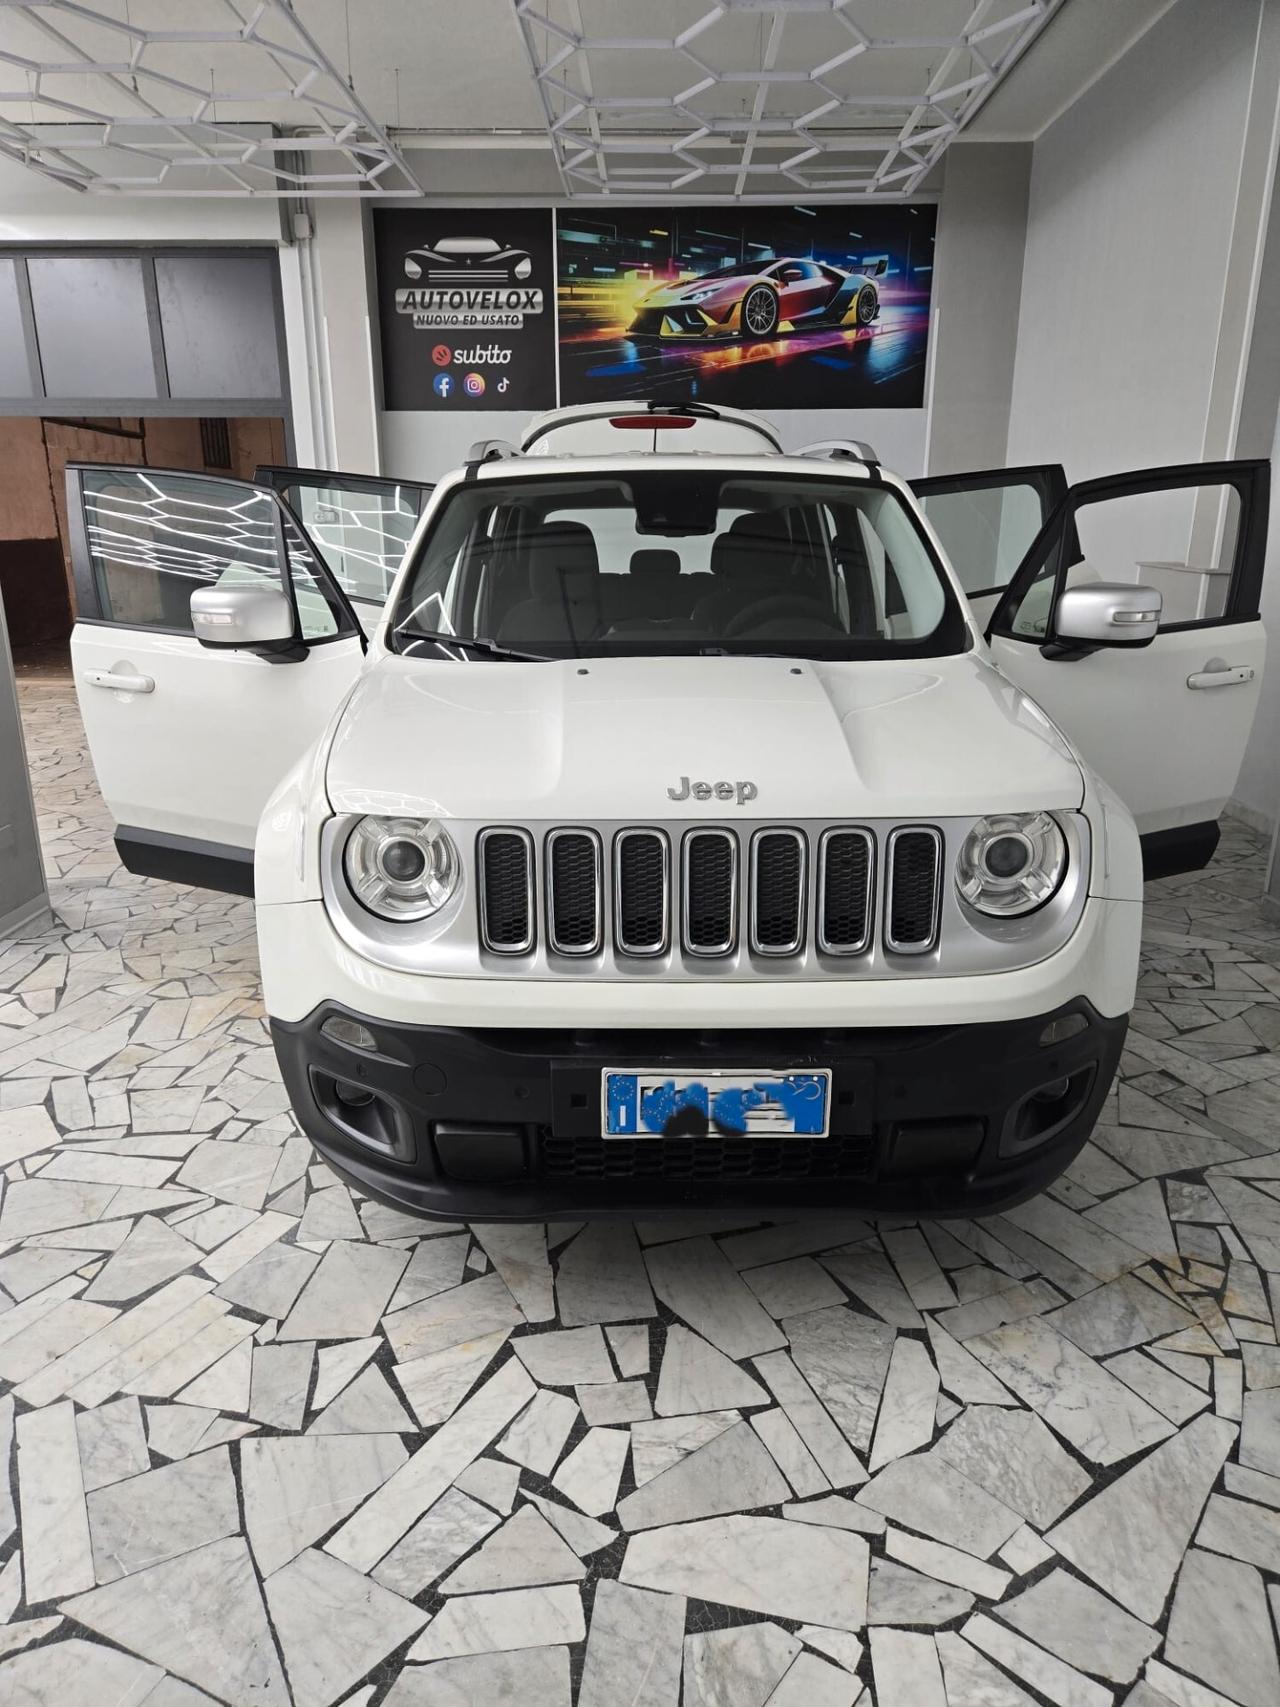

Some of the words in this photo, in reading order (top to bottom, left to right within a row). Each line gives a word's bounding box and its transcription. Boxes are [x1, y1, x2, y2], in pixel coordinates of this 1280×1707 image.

[402, 290, 538, 310] AUTOVELOX
[416, 315, 459, 326] NUOVO
[463, 315, 478, 326] ED
[481, 315, 520, 326] USATO
[453, 344, 512, 364] subito
[666, 776, 759, 805] Jeep
